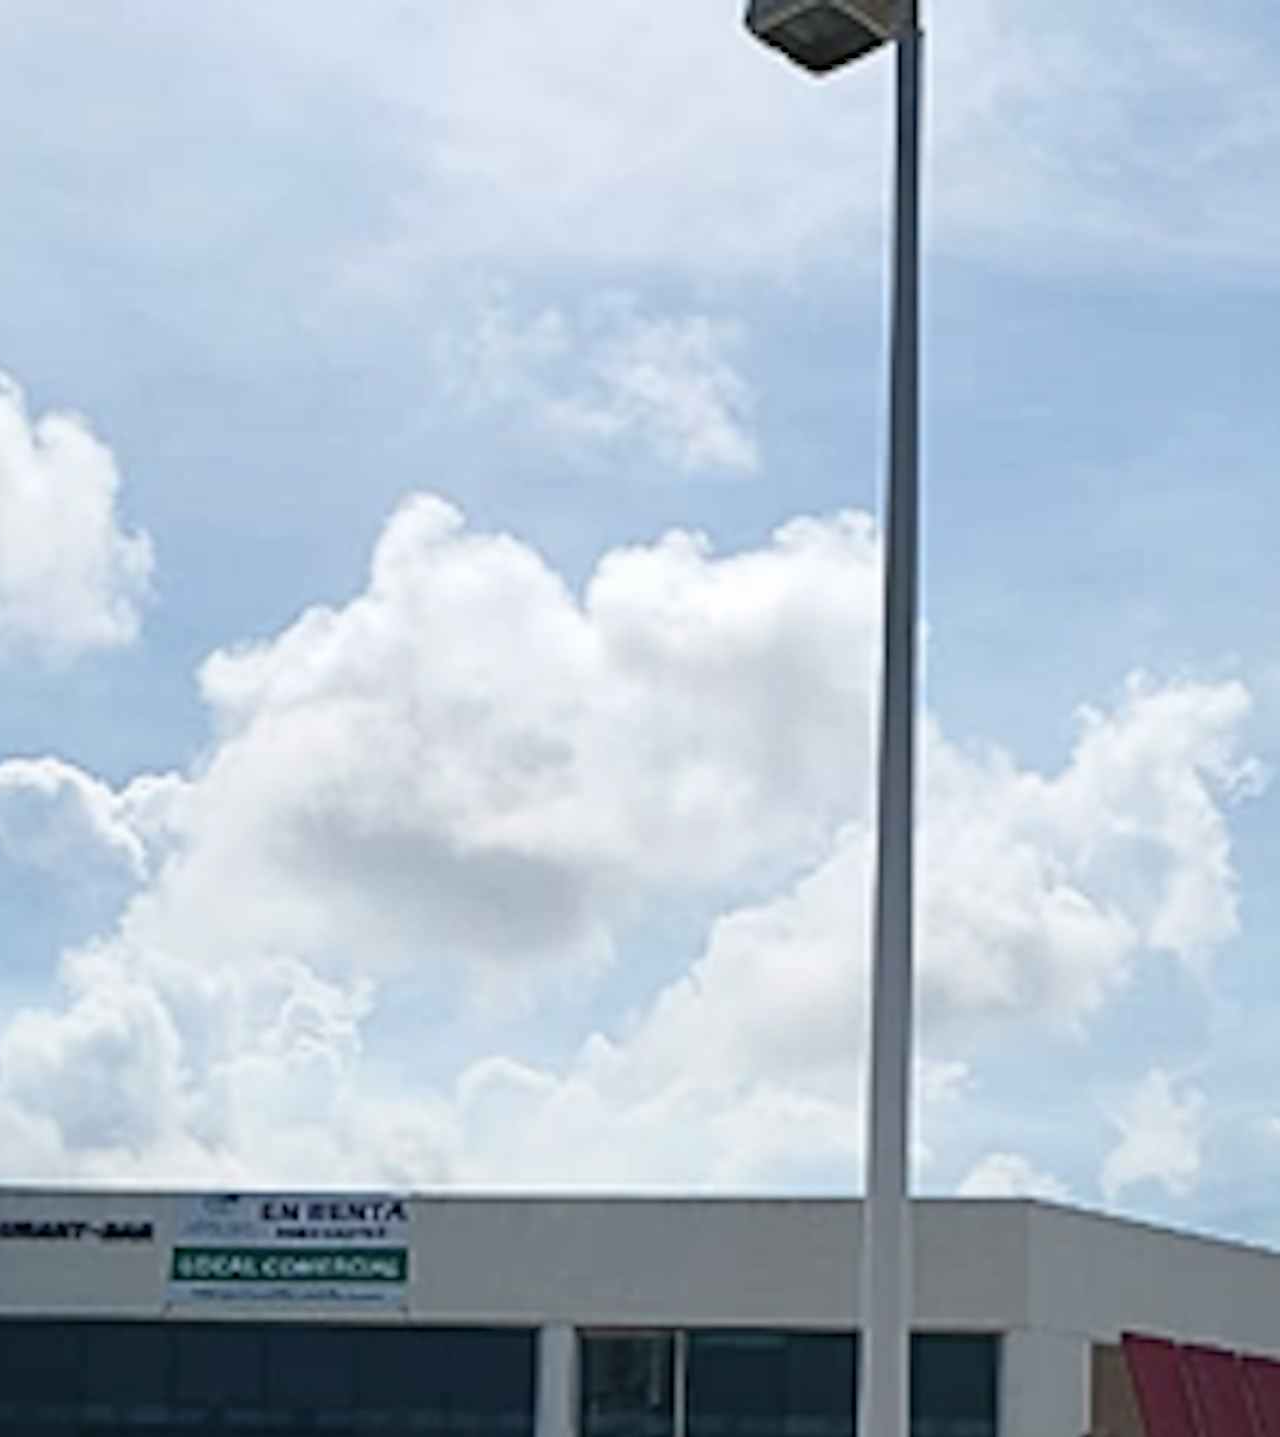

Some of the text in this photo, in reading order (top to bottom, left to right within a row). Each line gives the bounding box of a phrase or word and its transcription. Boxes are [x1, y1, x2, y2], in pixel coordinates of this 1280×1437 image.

[261, 1201, 409, 1221] EN RENTA
[177, 1255, 402, 1280] LOCAL COMERCIAL
